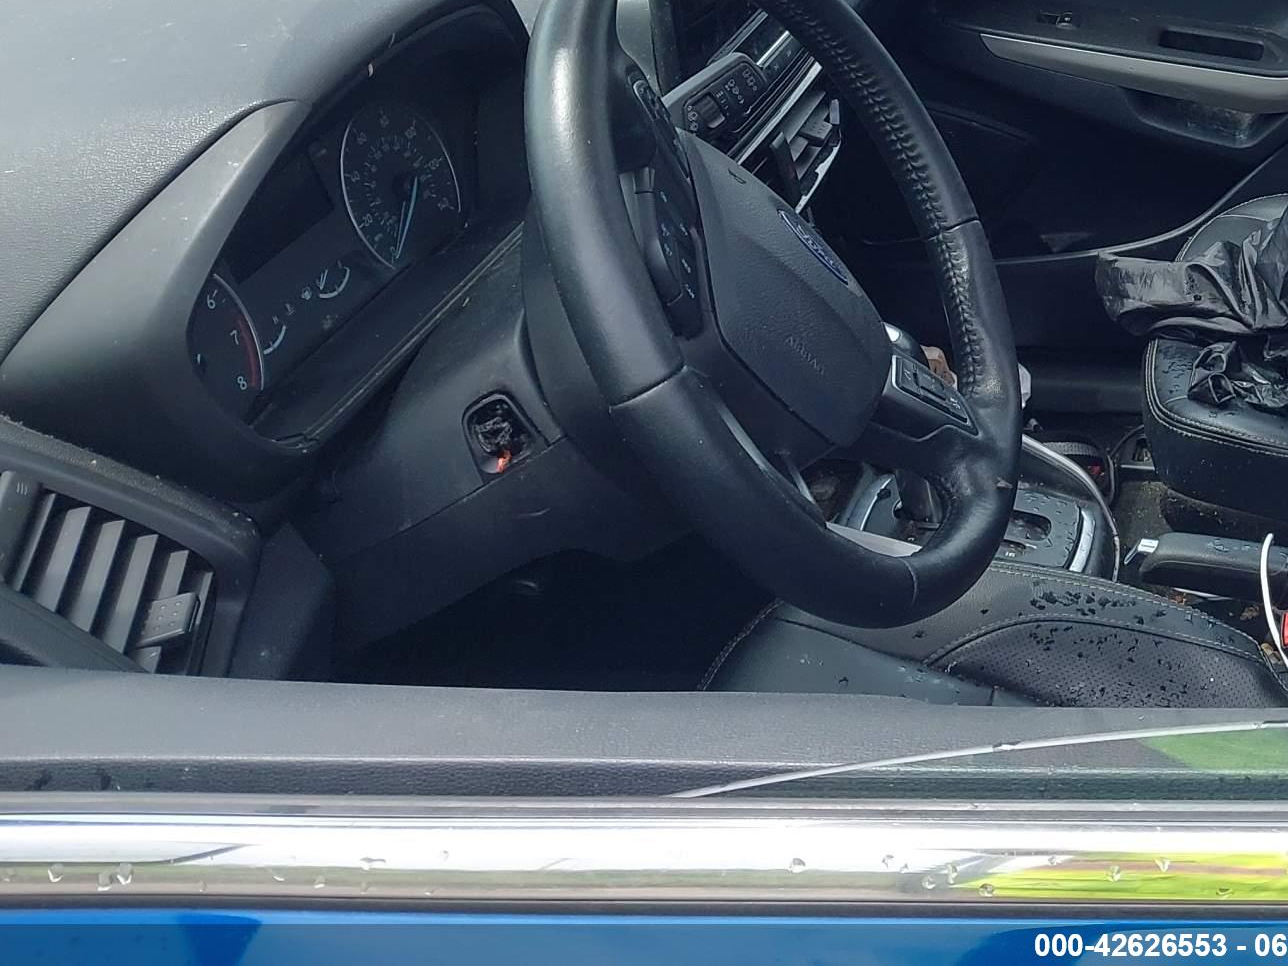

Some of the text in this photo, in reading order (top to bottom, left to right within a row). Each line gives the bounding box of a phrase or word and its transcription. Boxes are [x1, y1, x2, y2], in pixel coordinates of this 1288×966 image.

[207, 293, 216, 310] 6
[230, 329, 240, 346] 7
[236, 375, 248, 391] 8
